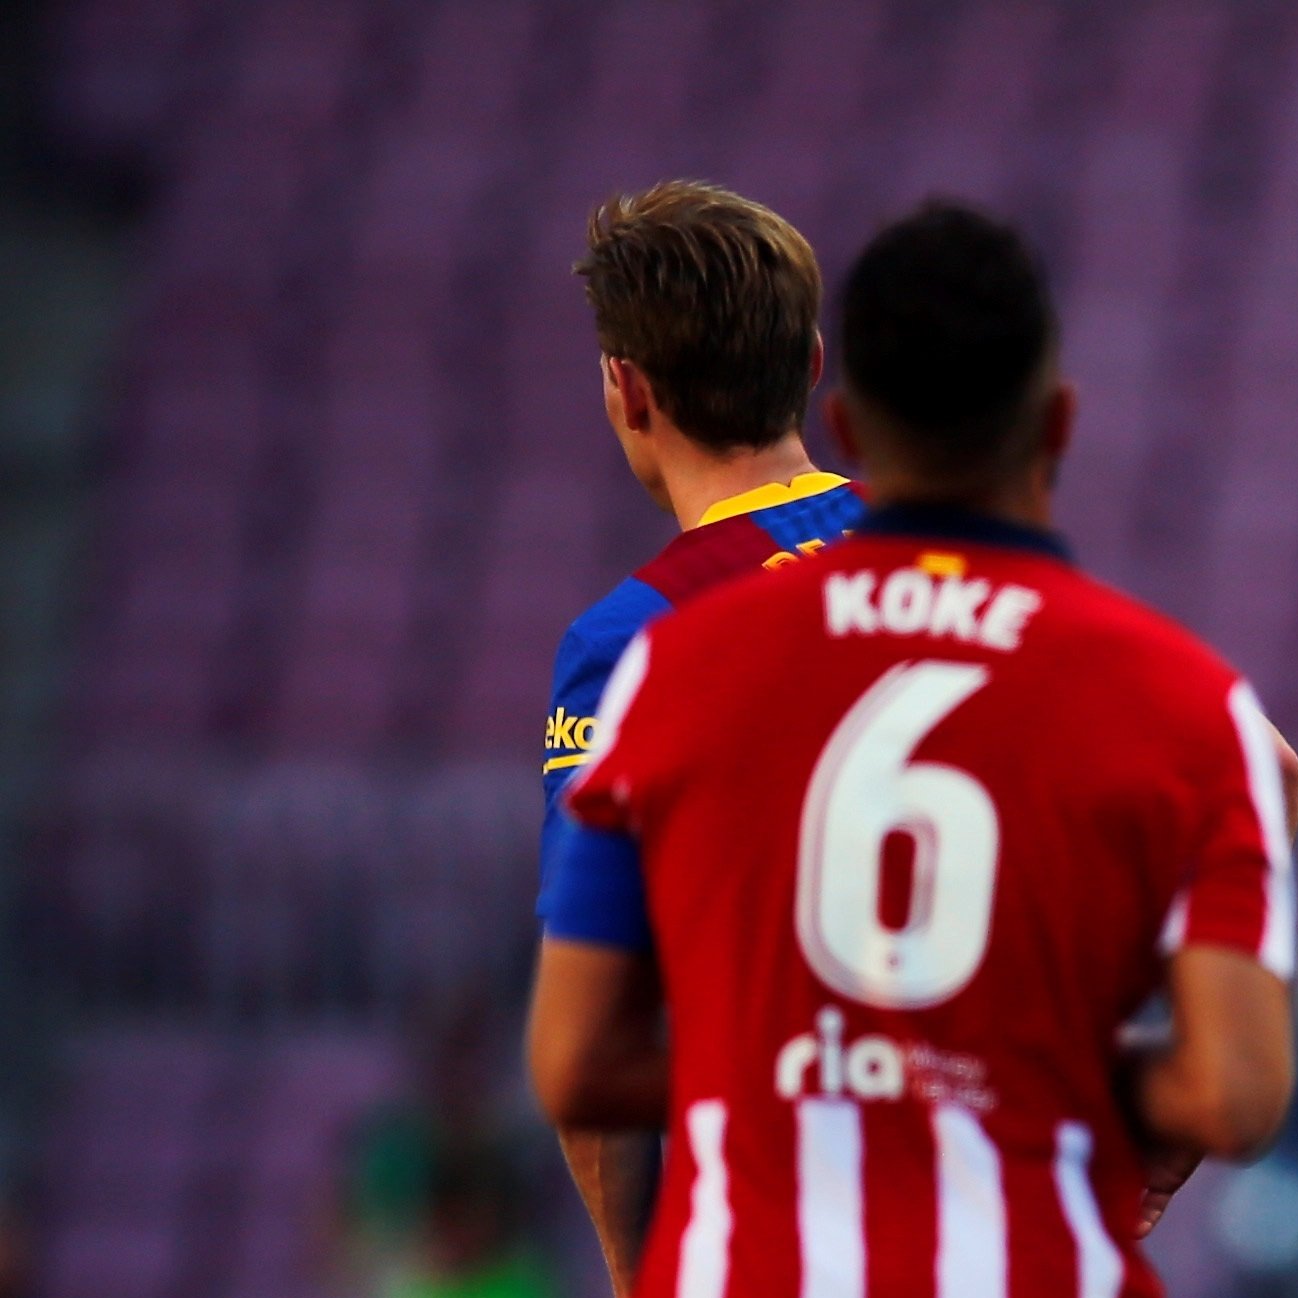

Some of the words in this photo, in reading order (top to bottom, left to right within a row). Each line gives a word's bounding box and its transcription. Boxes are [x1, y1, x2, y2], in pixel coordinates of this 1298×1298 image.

[824, 571, 1041, 652] KOKE
[796, 657, 1000, 1011] 6
[775, 1003, 905, 1101] ria
